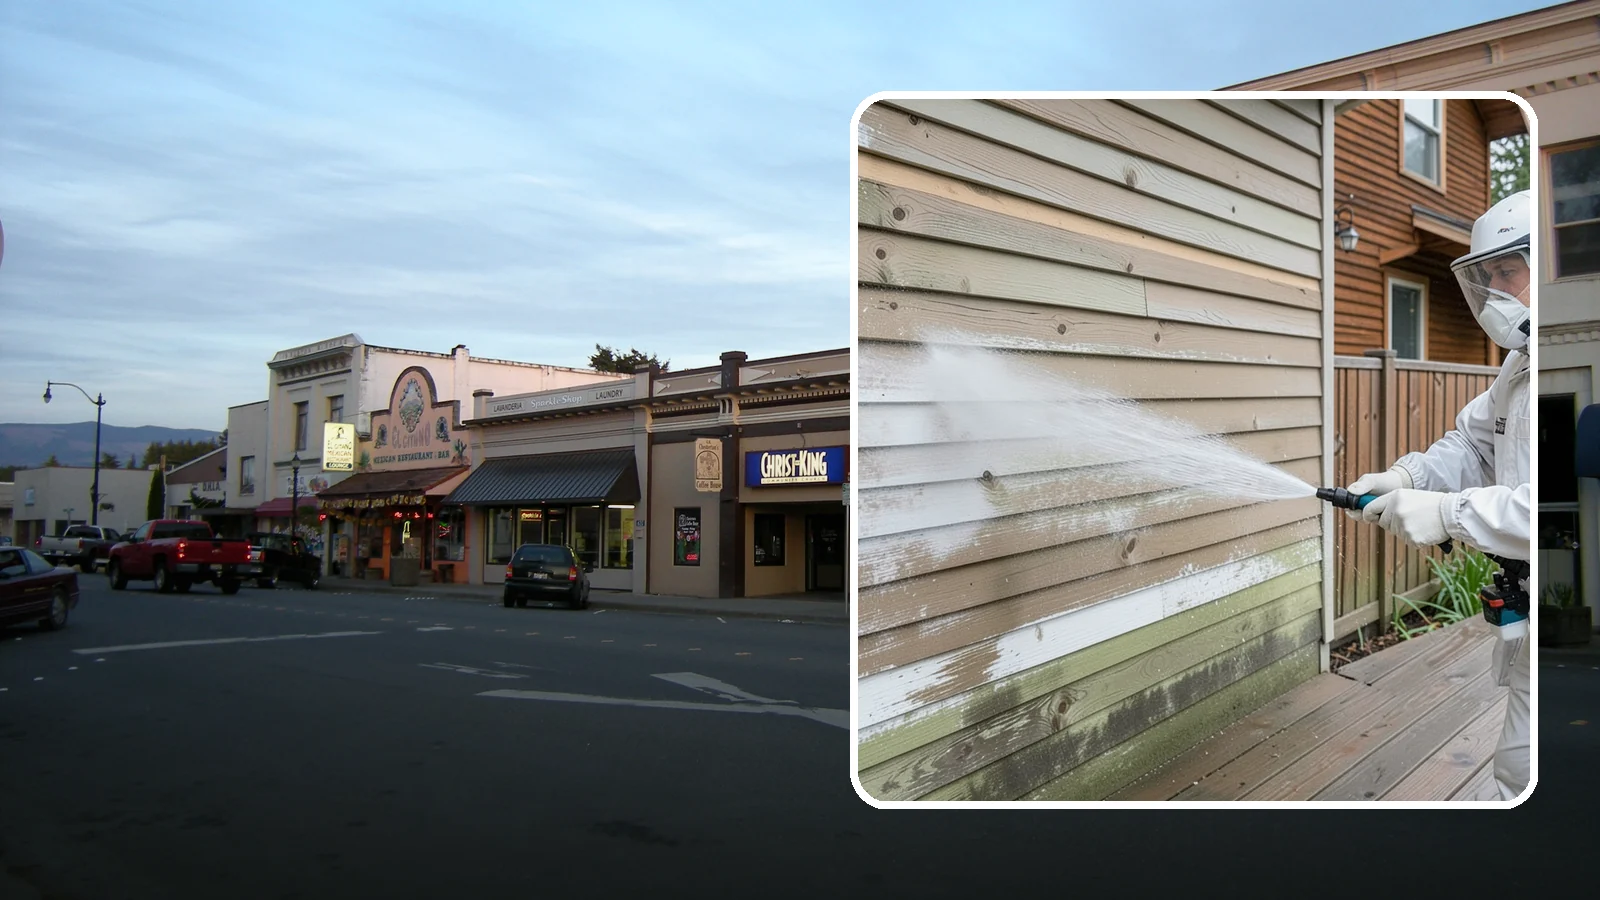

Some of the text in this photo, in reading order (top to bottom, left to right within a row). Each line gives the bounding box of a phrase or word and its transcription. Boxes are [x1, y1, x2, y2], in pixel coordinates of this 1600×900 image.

[493, 402, 522, 412] LAVANDERIA
[595, 388, 623, 400] LAUNDRY
[374, 450, 450, 464] MEXICAN RESTAURANT BAR
[761, 450, 827, 478] CHRIST KING
